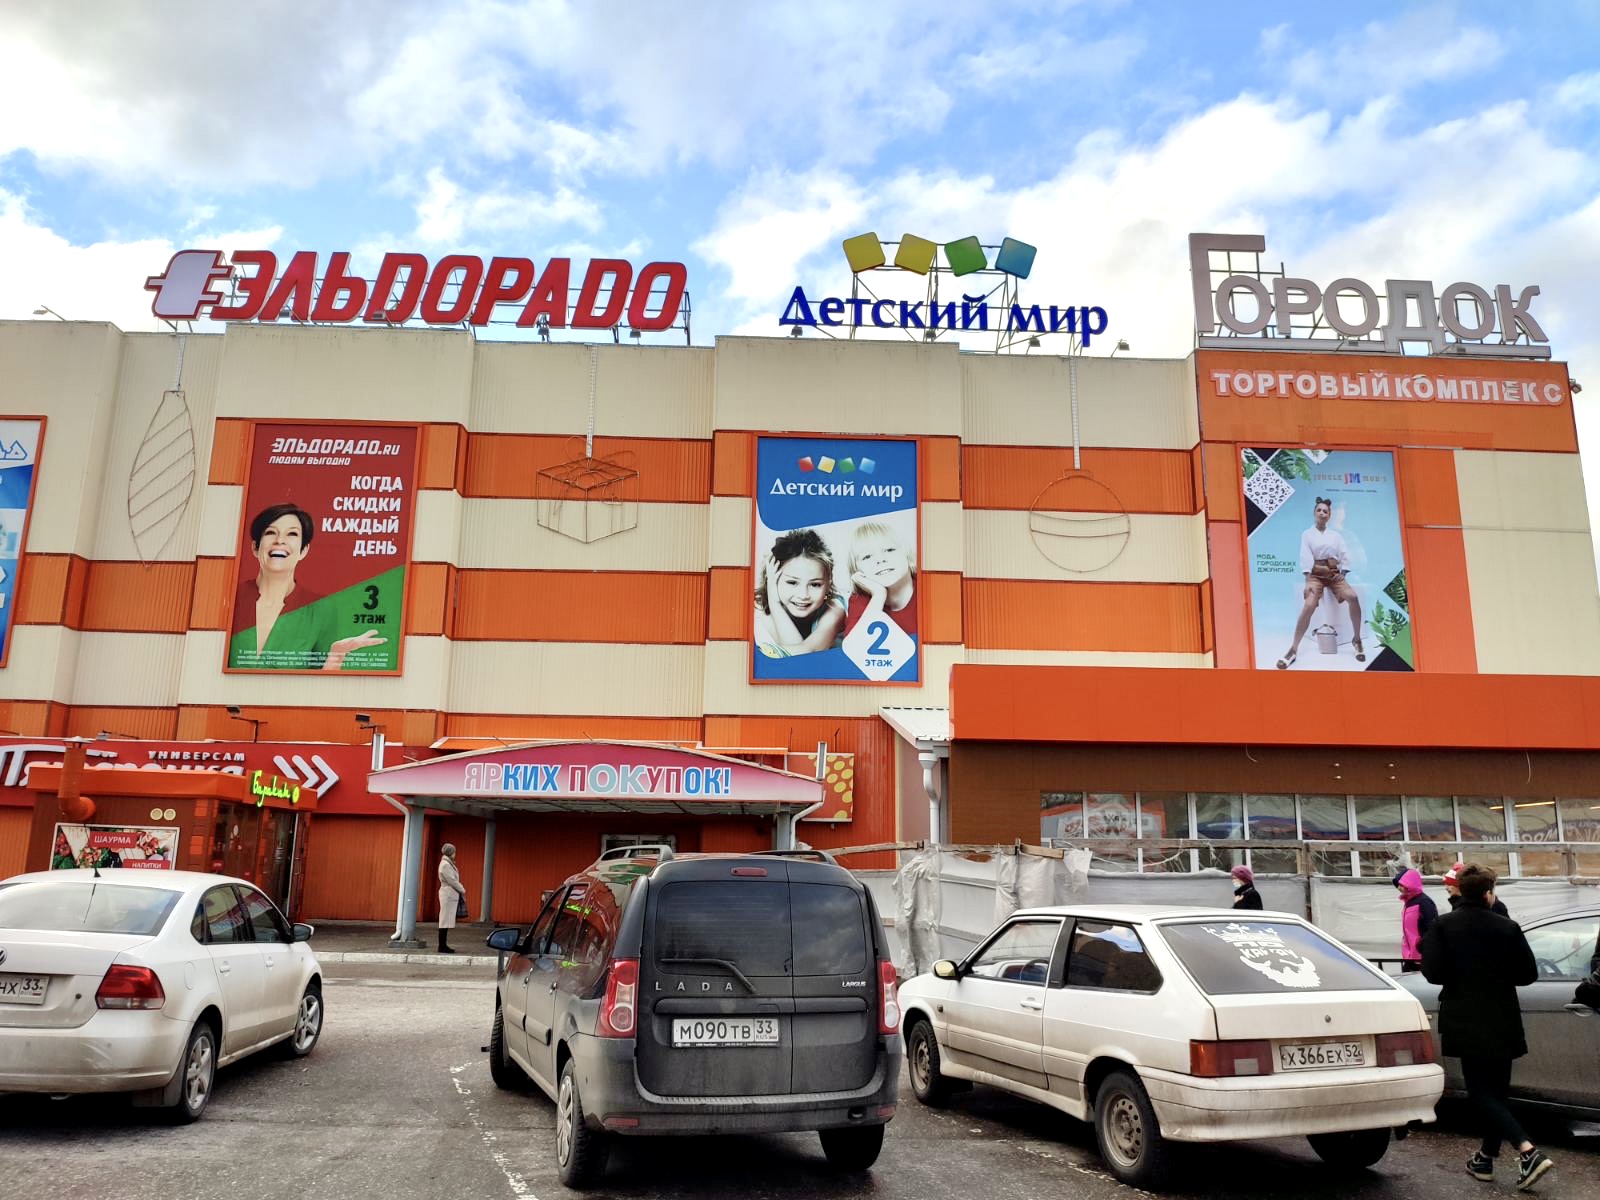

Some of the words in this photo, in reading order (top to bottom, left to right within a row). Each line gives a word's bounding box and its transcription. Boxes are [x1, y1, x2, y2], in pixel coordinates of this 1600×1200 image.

[779, 286, 989, 331] Детский
[1007, 303, 1109, 347] мир
[1212, 371, 1390, 399] ТОРГОВЫЙ
[268, 456, 305, 465] ЛЮДЯМ
[306, 457, 352, 466] ВЫГОДНО
[350, 475, 404, 492] КОГДА
[770, 478, 855, 497] Детский
[860, 484, 903, 502] мир
[332, 496, 401, 514] СКИДКИ
[321, 515, 399, 535] КАЖДЫЙ
[352, 539, 398, 557] ДЕНЬ
[363, 585, 380, 610] 3
[353, 613, 386, 625] этаж
[866, 620, 891, 656] 2
[864, 658, 893, 668] этаж
[148, 750, 245, 762] УНИВЕРСАМ
[464, 763, 561, 792] ЯРКИХ
[568, 764, 731, 795] ПОКУПОК!
[94, 835, 131, 845] ШАУРМА
[655, 981, 734, 992] LADA
